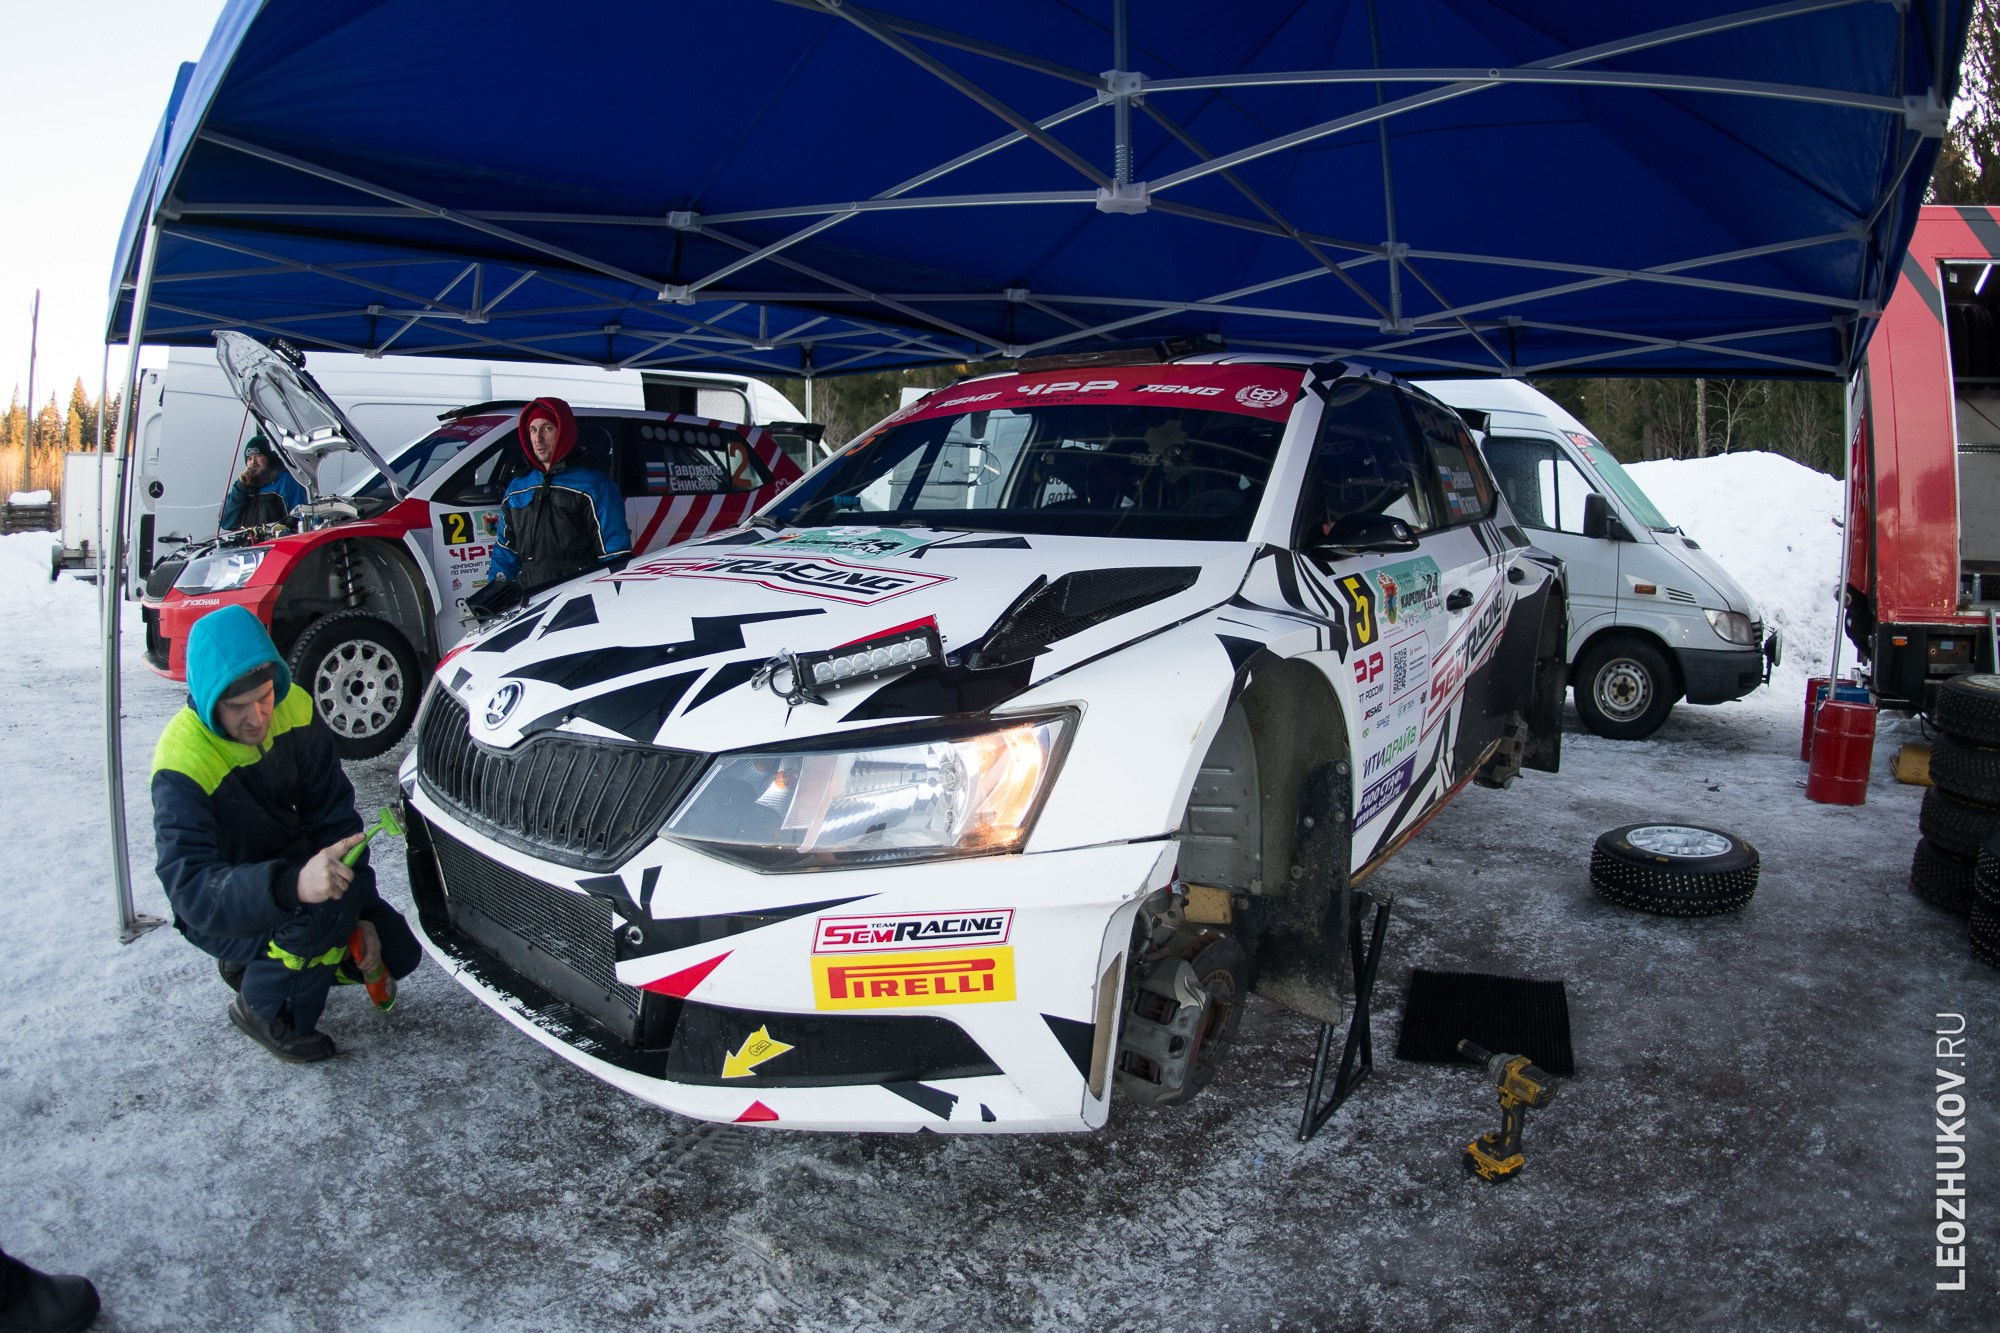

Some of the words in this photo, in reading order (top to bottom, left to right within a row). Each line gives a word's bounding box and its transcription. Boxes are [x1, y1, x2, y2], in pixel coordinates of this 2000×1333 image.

[1017, 381, 1119, 395] ЧРР
[729, 442, 752, 488] 2
[448, 513, 467, 544] 2
[450, 561, 483, 570] ЧЕМПИОНАТ
[181, 599, 220, 607] YOKOHAMA
[1343, 577, 1371, 644] 5
[1362, 725, 1417, 779] ИТИДРАЙВ
[827, 958, 996, 999] PIRELLI
